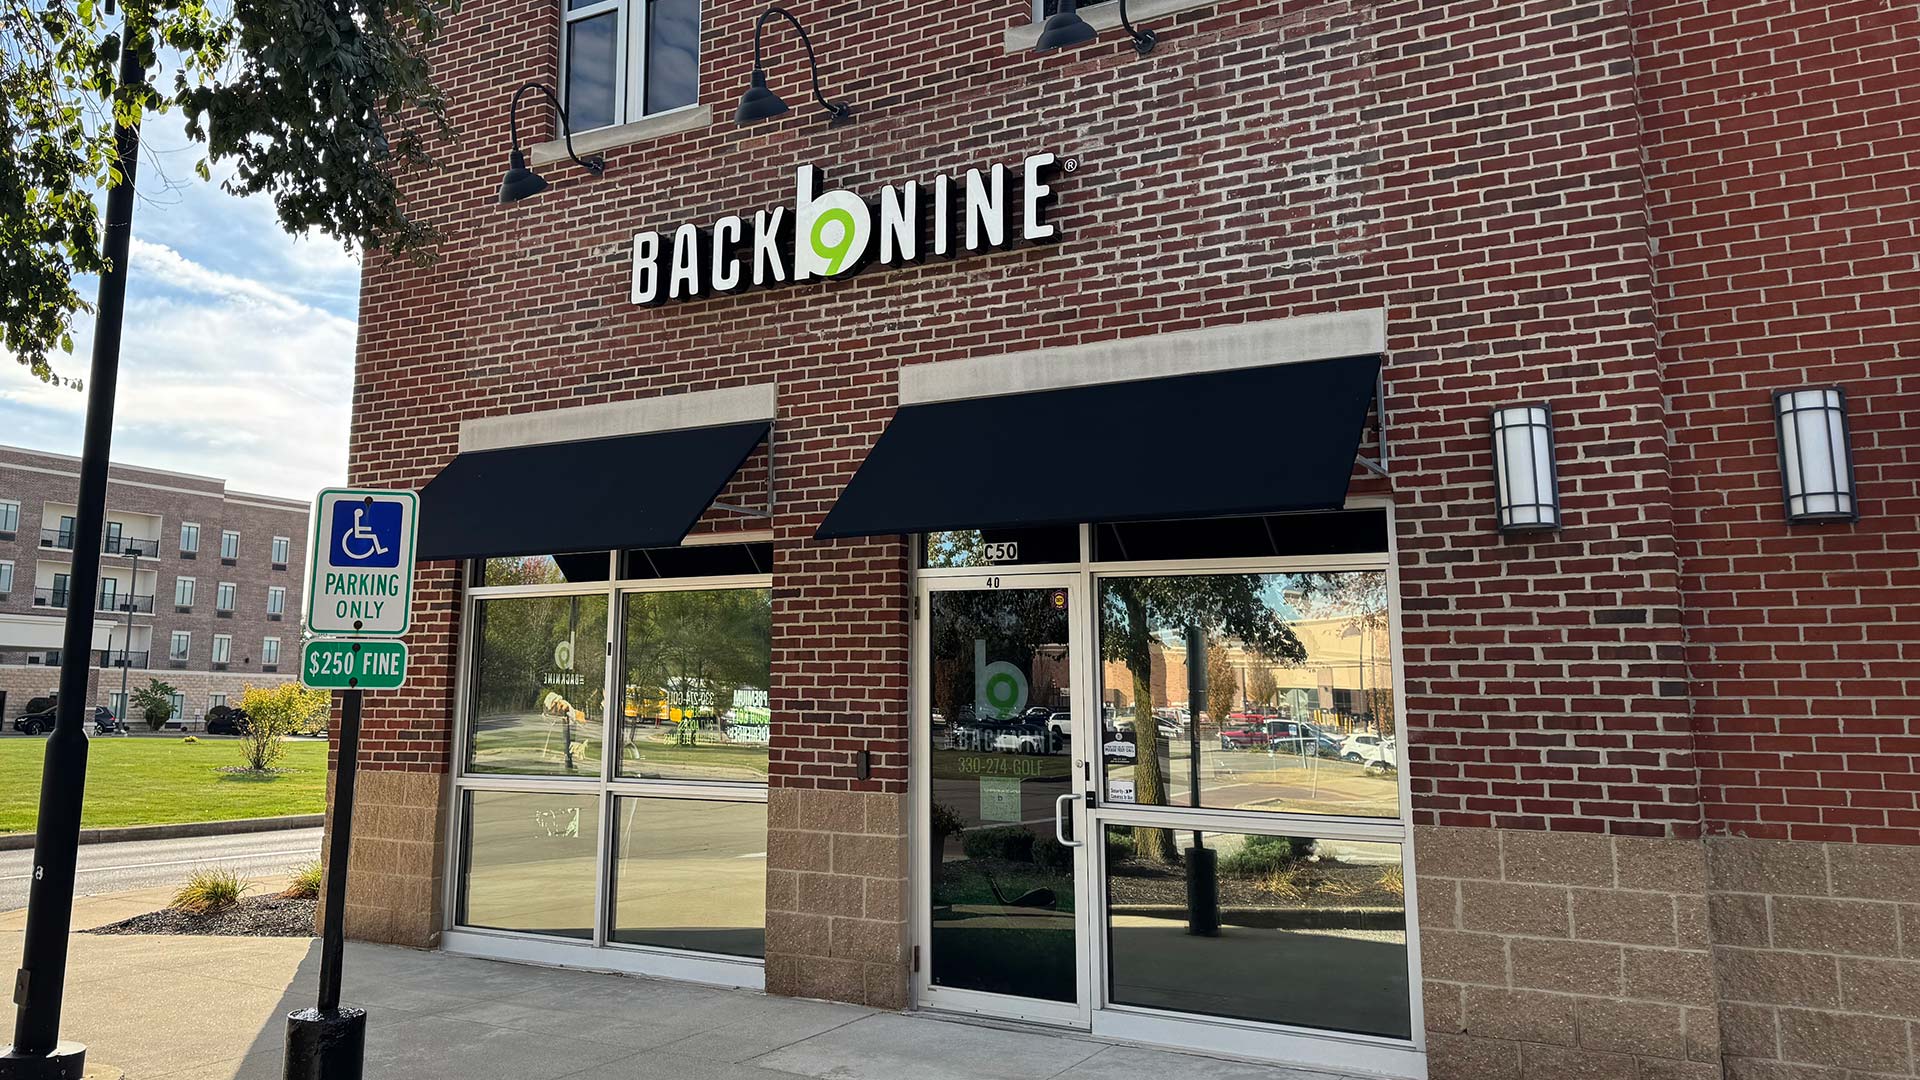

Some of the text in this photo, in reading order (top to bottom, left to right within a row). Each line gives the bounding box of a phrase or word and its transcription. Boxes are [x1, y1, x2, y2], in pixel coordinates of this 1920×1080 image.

[631, 205, 786, 304] BACK
[880, 152, 1056, 264] NINE
[984, 542, 1018, 560] C50
[325, 572, 399, 597] PARKING
[986, 577, 1000, 589] 40
[336, 600, 385, 619] ONLY
[309, 650, 400, 677] $250 FINE
[958, 756, 1044, 776] 330-274-GOLF
